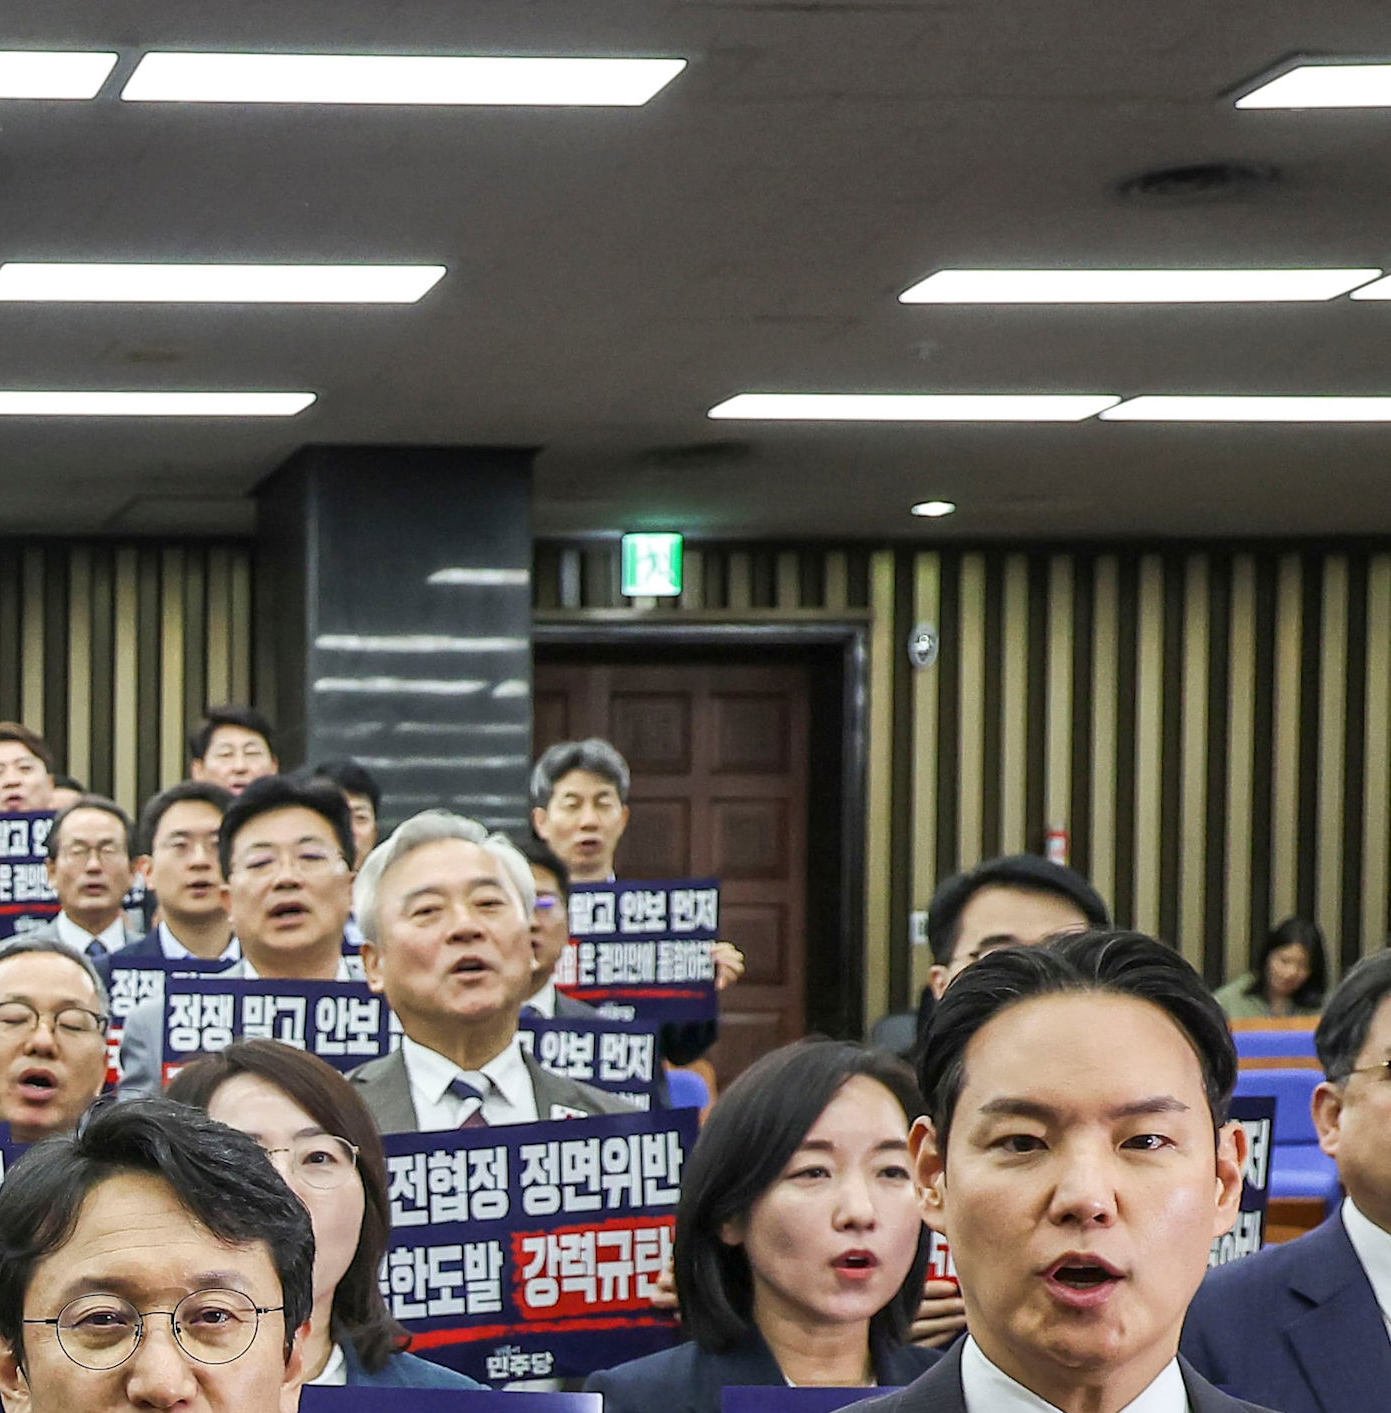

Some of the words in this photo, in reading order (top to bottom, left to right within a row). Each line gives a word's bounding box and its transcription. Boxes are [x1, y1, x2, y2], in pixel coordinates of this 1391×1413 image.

[169, 994, 234, 1051] 정쟁
[316, 996, 380, 1054] 안보
[599, 1032, 655, 1082] 먼저
[386, 1147, 509, 1227] 전협정
[520, 1132, 684, 1216] 정면위반
[379, 1241, 504, 1320] 한도발
[523, 1227, 674, 1308] 강력규탄
[487, 1350, 554, 1379] 민주당
